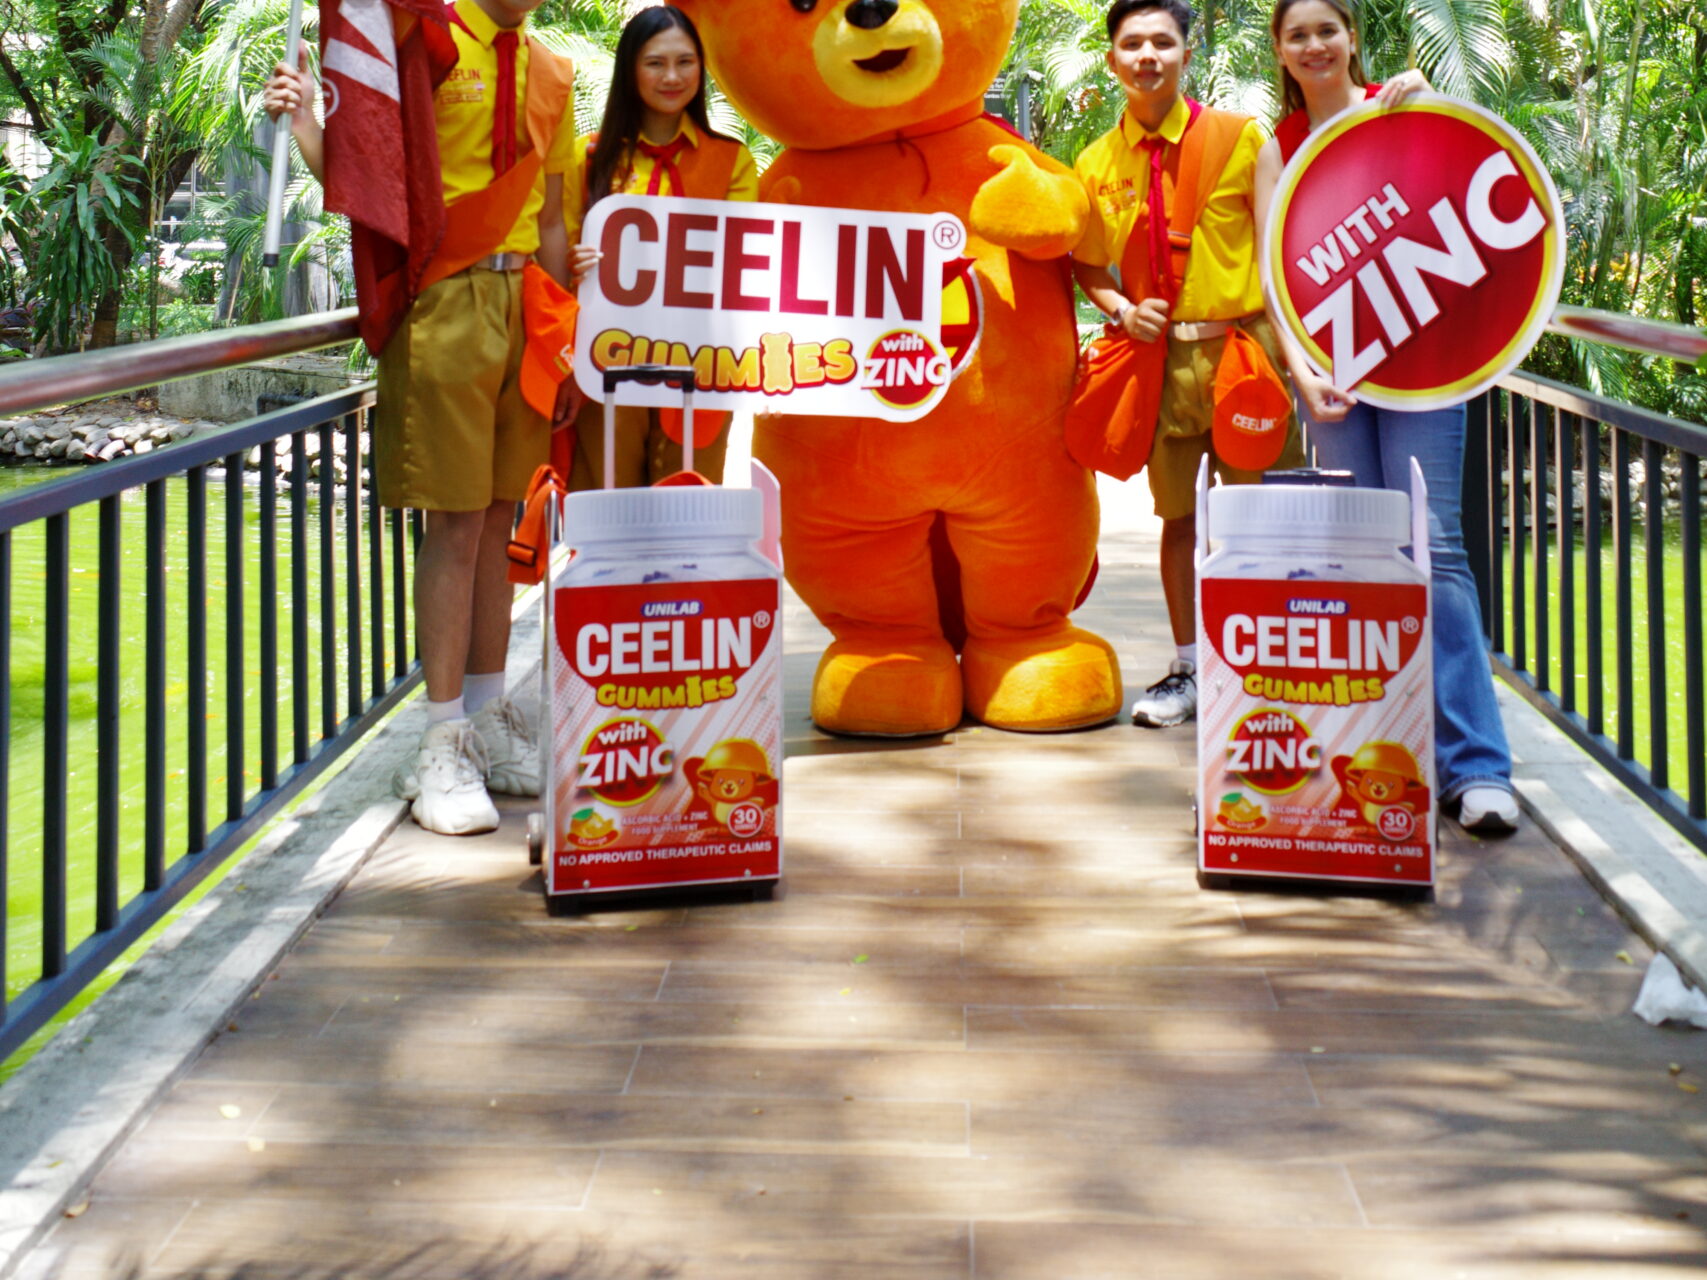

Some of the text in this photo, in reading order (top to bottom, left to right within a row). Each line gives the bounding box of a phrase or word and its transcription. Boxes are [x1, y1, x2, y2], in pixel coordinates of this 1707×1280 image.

[1296, 182, 1410, 287] WITH
[1302, 150, 1546, 392] ZINC
[881, 333, 924, 352] with
[591, 328, 857, 395] GUMMIES
[861, 355, 948, 389] ZINC
[644, 602, 700, 617] UNILAB
[1290, 600, 1347, 614] UNILAB
[596, 676, 737, 709] GUMMIES
[1243, 673, 1385, 707] GUMMIES
[598, 721, 647, 744] with
[1245, 713, 1294, 733] with
[577, 743, 673, 787] ZINC
[1226, 737, 1321, 772] ZINC
[735, 808, 757, 824] 30
[1384, 812, 1407, 827] 30
[559, 840, 771, 866] NO APPROVED THERAPEUTIC CLAIMS
[1208, 835, 1423, 857] NO APPROVED THERAPEUTIC CLAIMS
